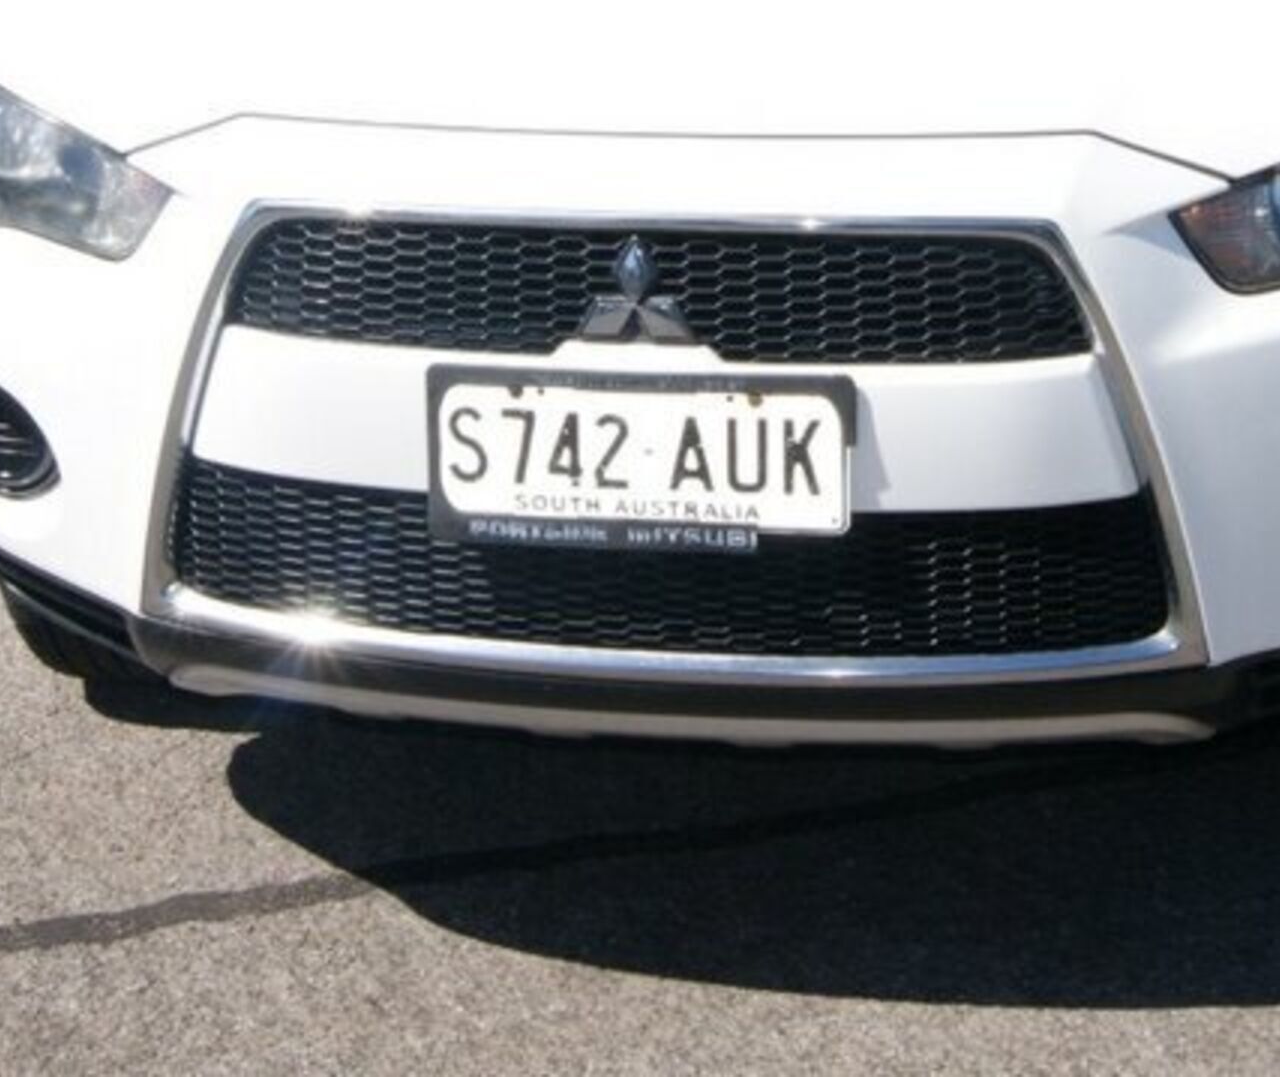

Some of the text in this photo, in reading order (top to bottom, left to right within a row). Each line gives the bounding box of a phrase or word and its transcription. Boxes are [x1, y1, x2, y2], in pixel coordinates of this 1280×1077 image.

[448, 407, 821, 496] S742 AUK
[514, 494, 760, 520] SOUTH AUSTRALIA
